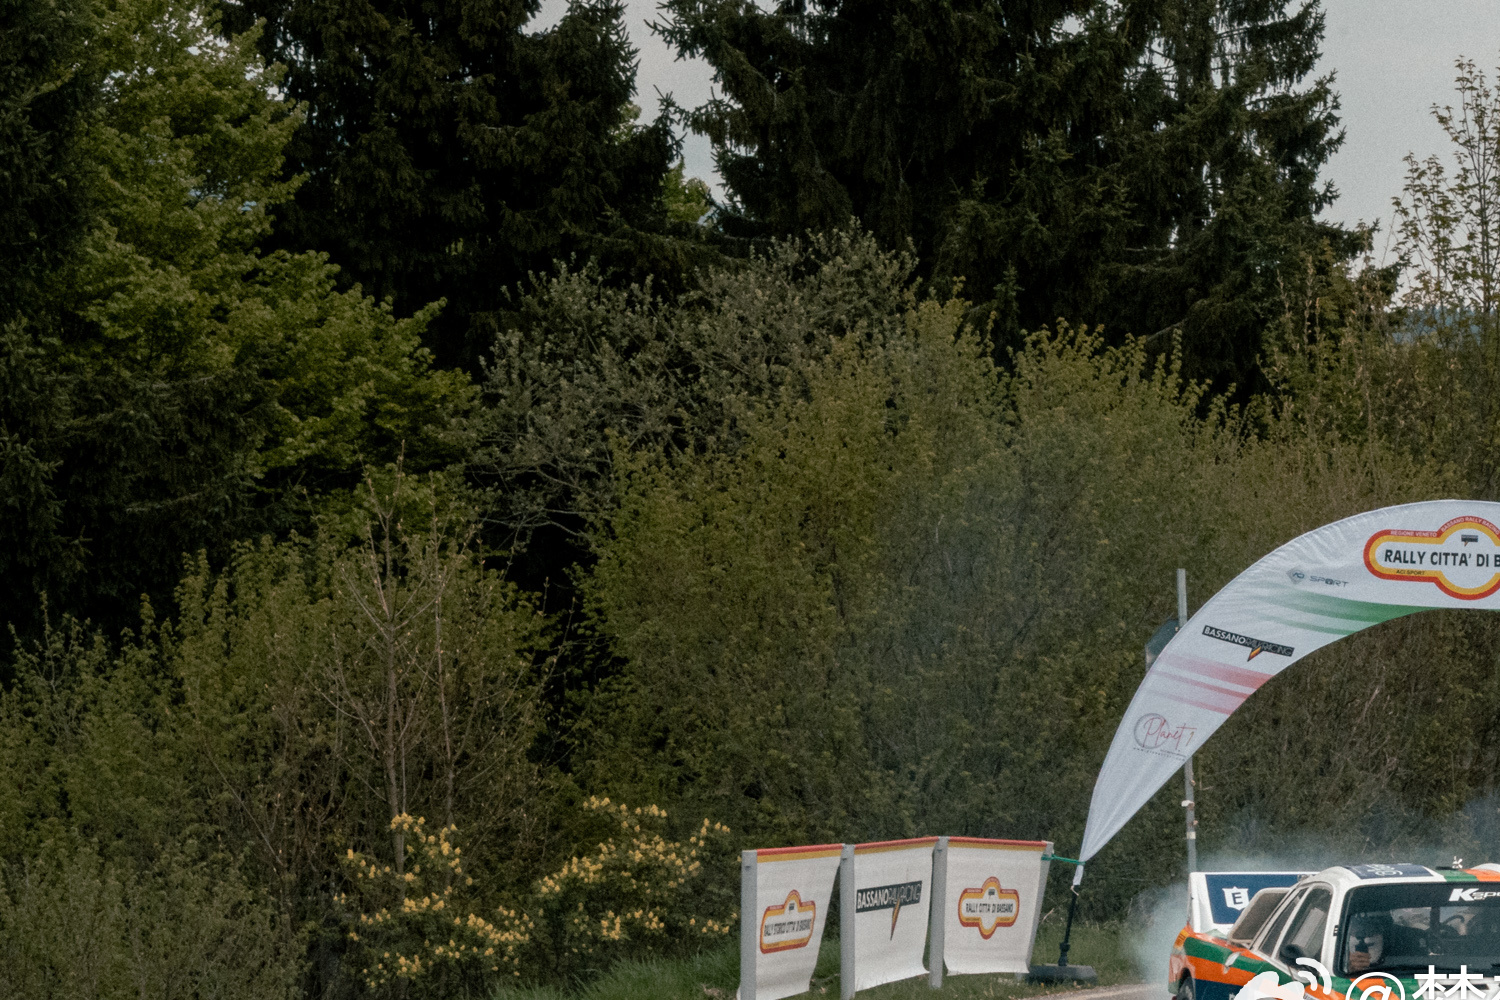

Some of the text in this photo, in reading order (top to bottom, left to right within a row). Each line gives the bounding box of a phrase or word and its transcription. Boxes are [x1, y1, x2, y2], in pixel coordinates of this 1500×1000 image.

[1384, 549, 1426, 565] RALLY
[1430, 551, 1472, 567] CITTA'
[1476, 553, 1490, 568] DI
[1309, 575, 1349, 588] SPORT
[1232, 890, 1244, 905] E
